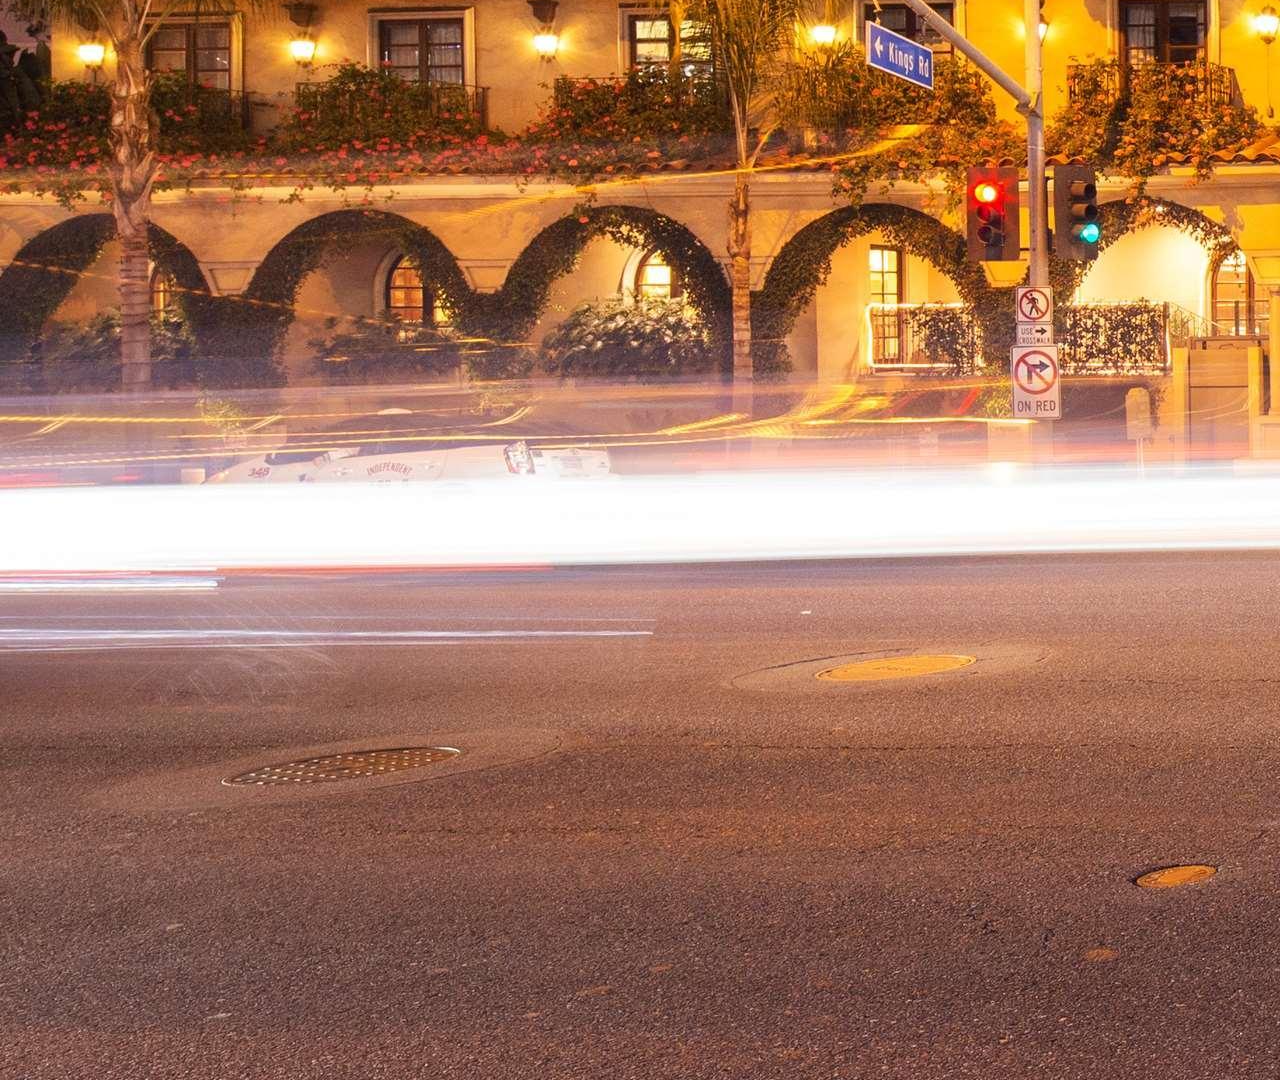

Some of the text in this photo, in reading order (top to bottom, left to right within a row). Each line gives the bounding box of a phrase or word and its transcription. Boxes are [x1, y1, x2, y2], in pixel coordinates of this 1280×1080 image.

[889, 41, 929, 78] Kings Rd
[1020, 327, 1033, 336] USE
[1019, 337, 1051, 345] CROSSWALK
[1017, 400, 1056, 412] ON RED
